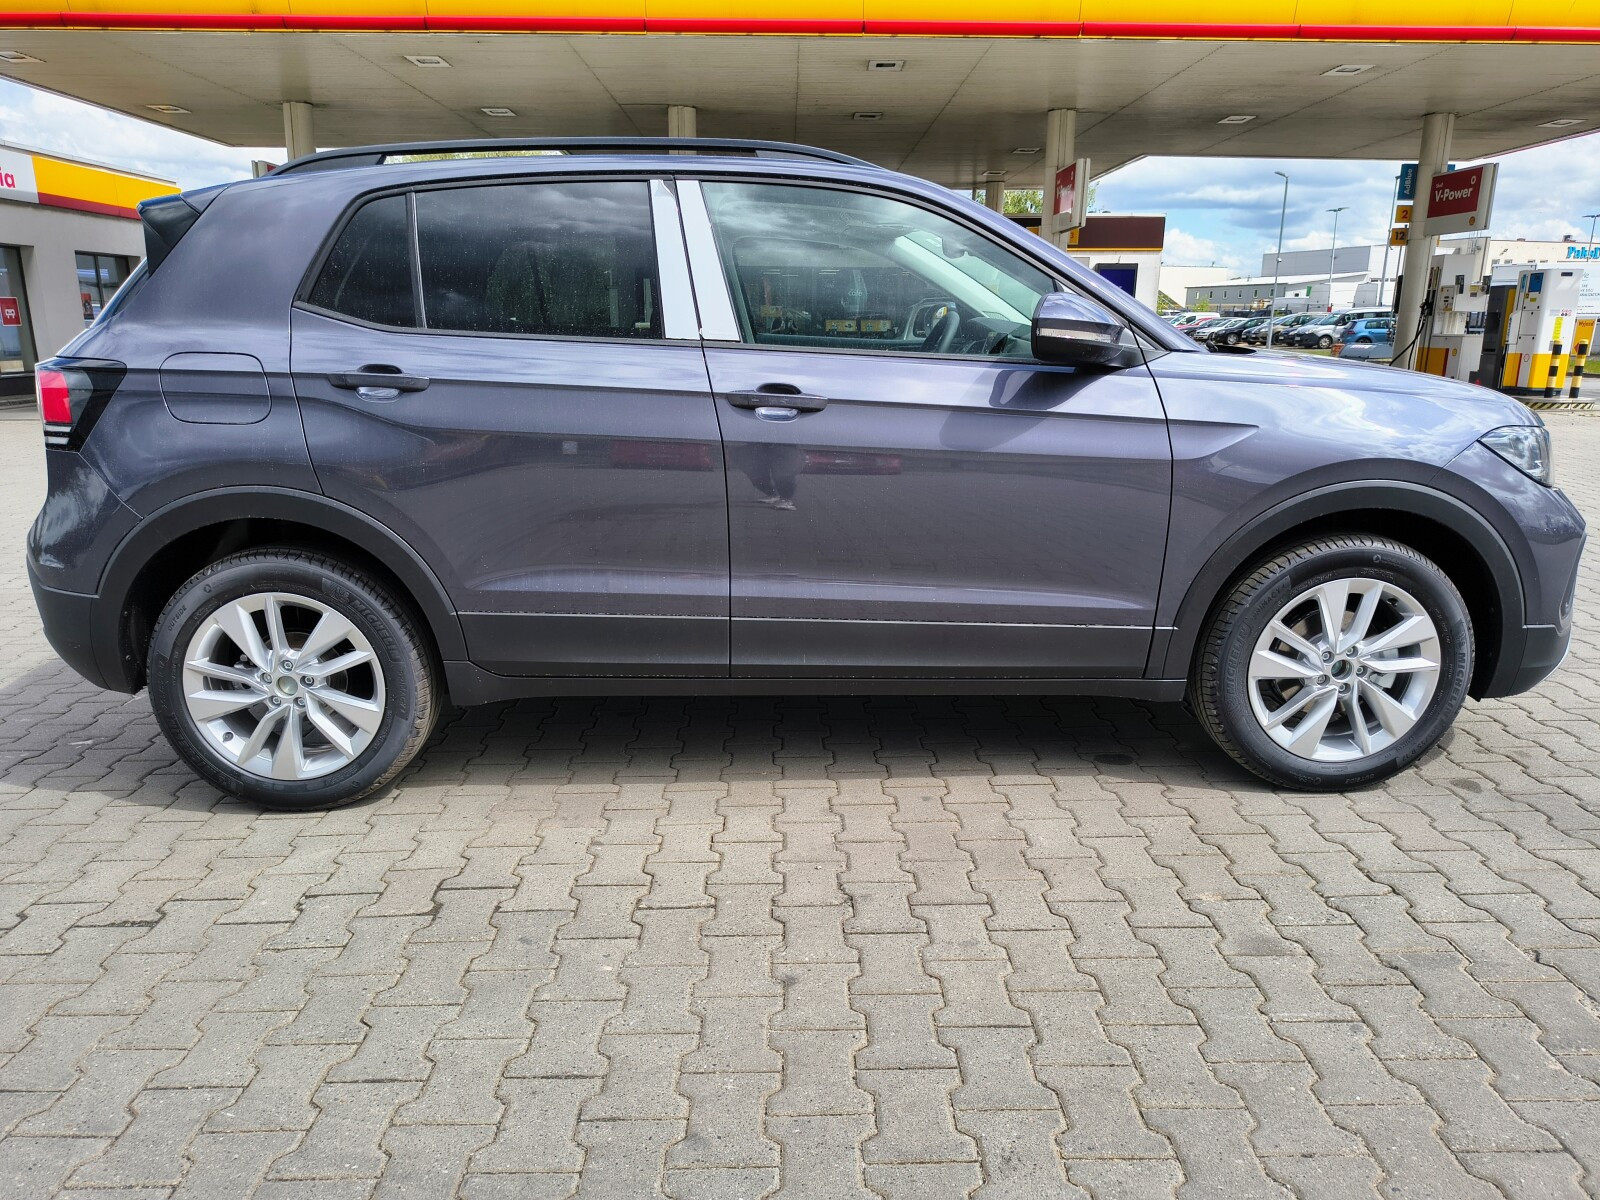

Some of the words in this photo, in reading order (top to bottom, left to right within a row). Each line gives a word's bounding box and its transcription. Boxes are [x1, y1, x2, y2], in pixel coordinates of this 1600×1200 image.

[1404, 168, 1412, 195] AdBlue
[1435, 187, 1473, 202] V-Power
[1402, 209, 1408, 219] 2
[1395, 231, 1405, 241] 12
[167, 604, 187, 632] OUTSIDE
[352, 600, 401, 662] MICHELIN
[1444, 651, 1466, 718] MICHELIN
